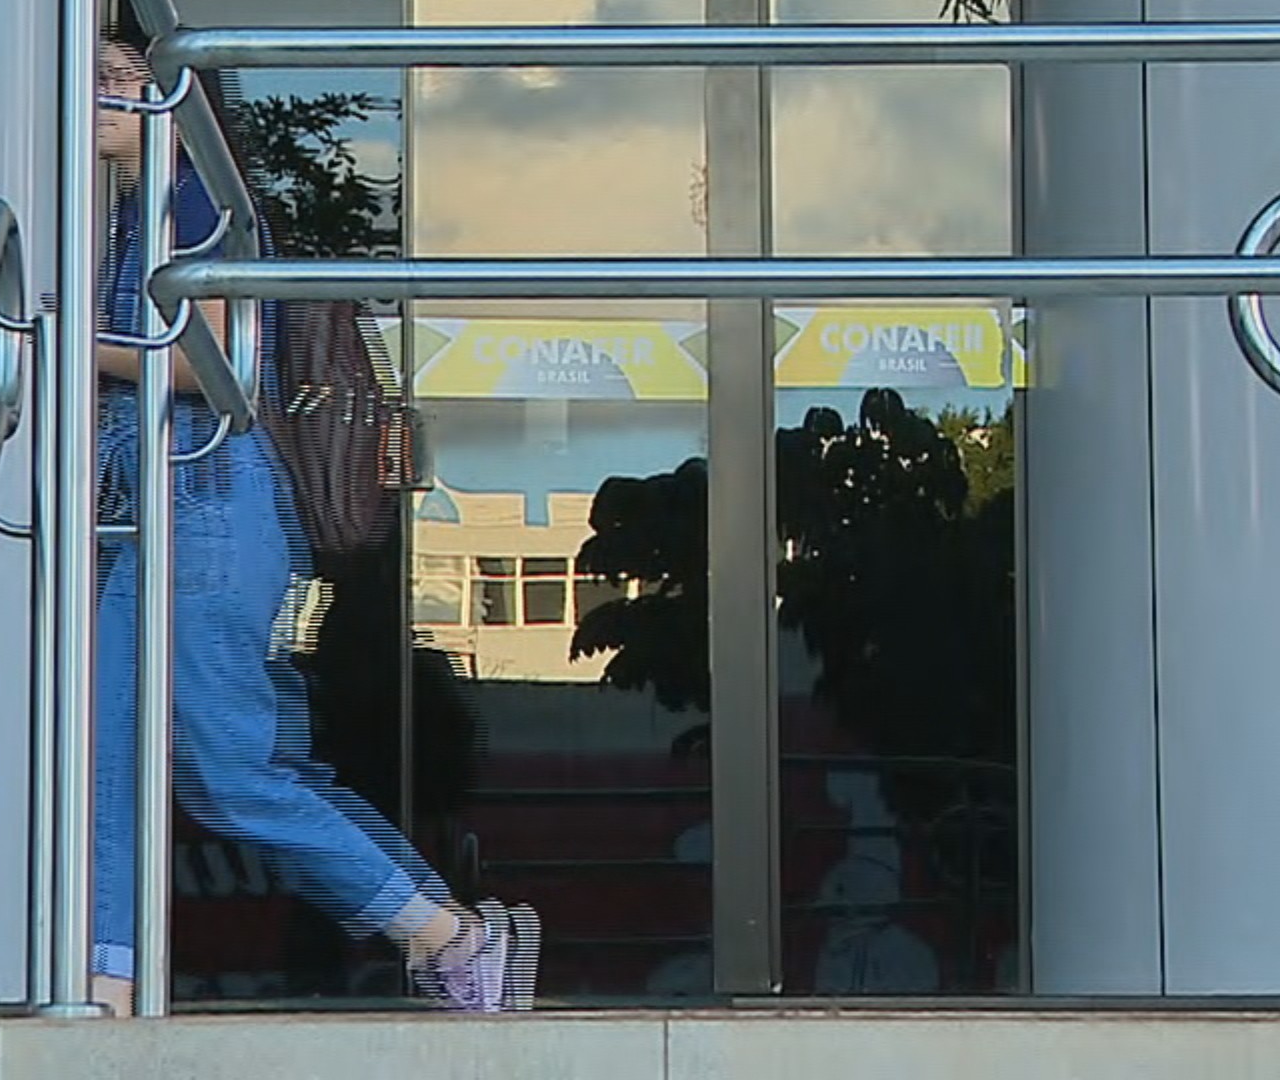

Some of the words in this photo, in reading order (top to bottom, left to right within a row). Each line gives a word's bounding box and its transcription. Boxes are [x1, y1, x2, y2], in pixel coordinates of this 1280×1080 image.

[473, 335, 656, 366] CONAFER
[878, 358, 927, 372] BRASIL
[536, 370, 592, 385] BRASIL
